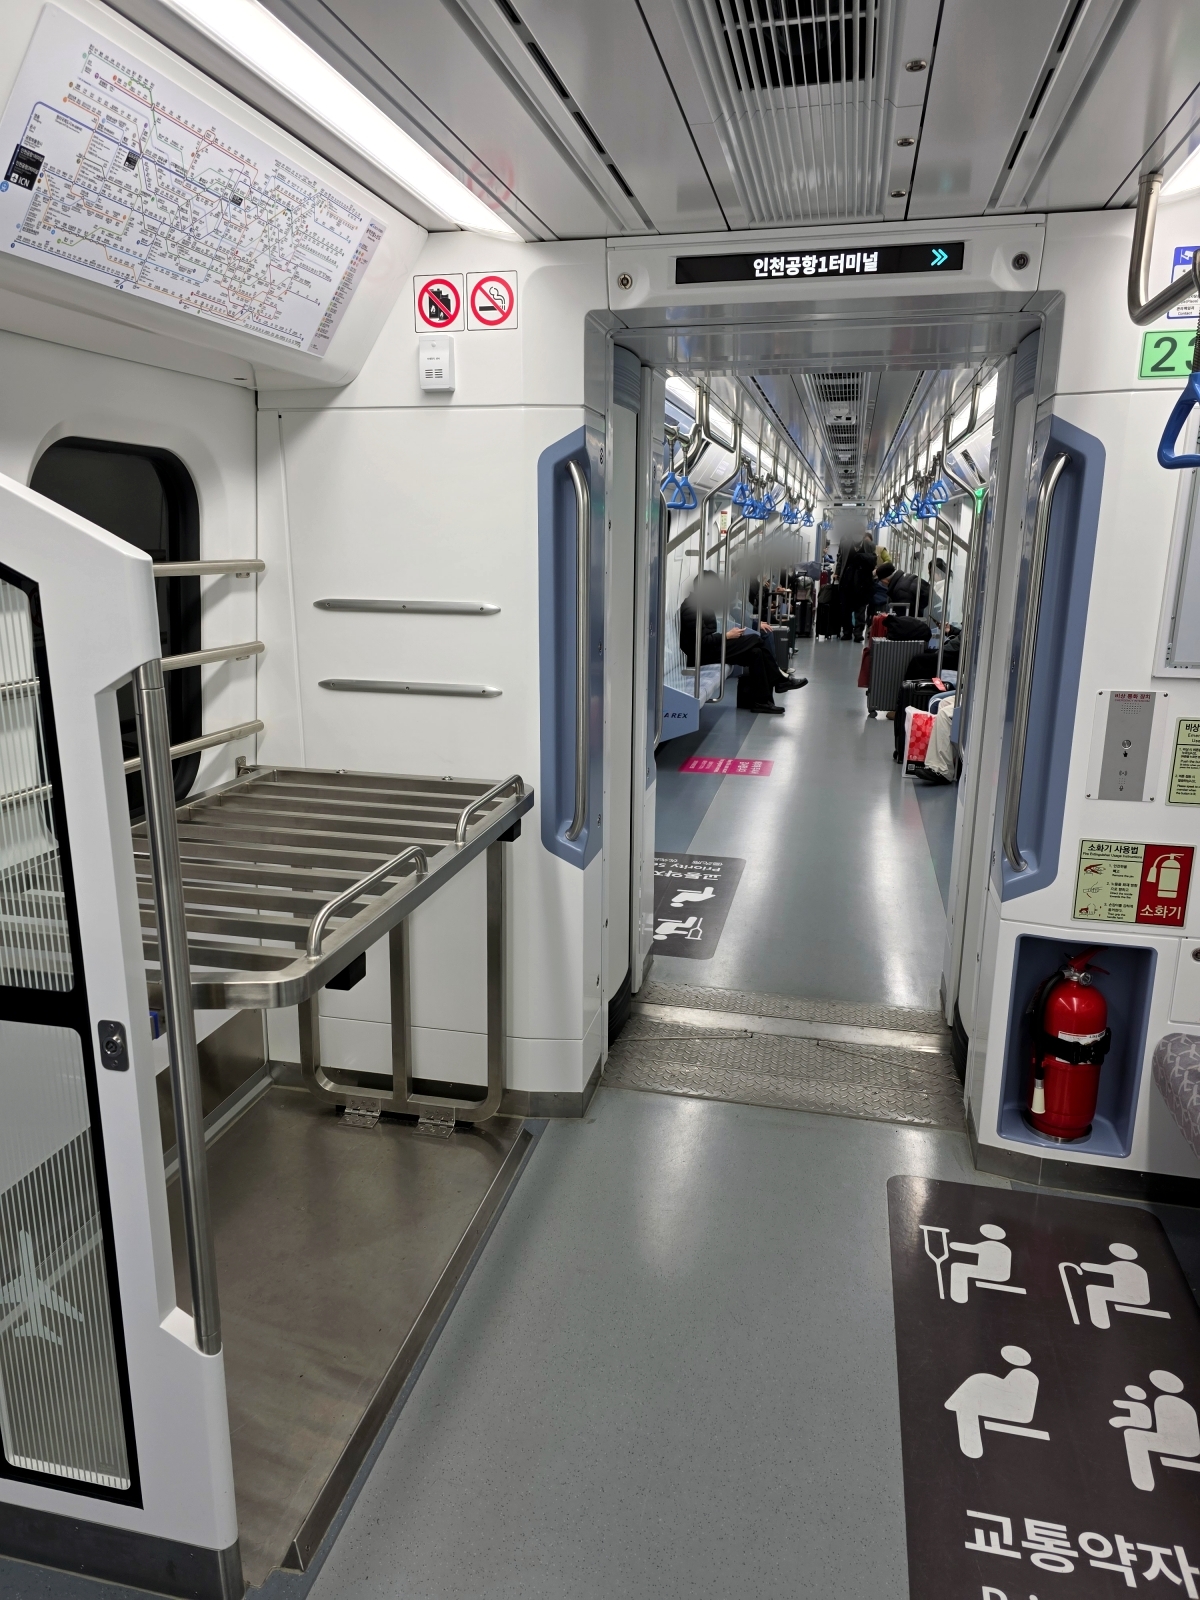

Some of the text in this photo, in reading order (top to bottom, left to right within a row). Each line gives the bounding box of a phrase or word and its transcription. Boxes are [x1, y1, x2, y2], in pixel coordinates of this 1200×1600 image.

[18, 176, 30, 187] ICN
[753, 251, 879, 277] 인천공항1터미널
[1088, 844, 1139, 854] 소화기 사용법
[670, 863, 721, 872] Priority
[1140, 904, 1181, 920] 소화기
[965, 1509, 1200, 1599] 교통약자
